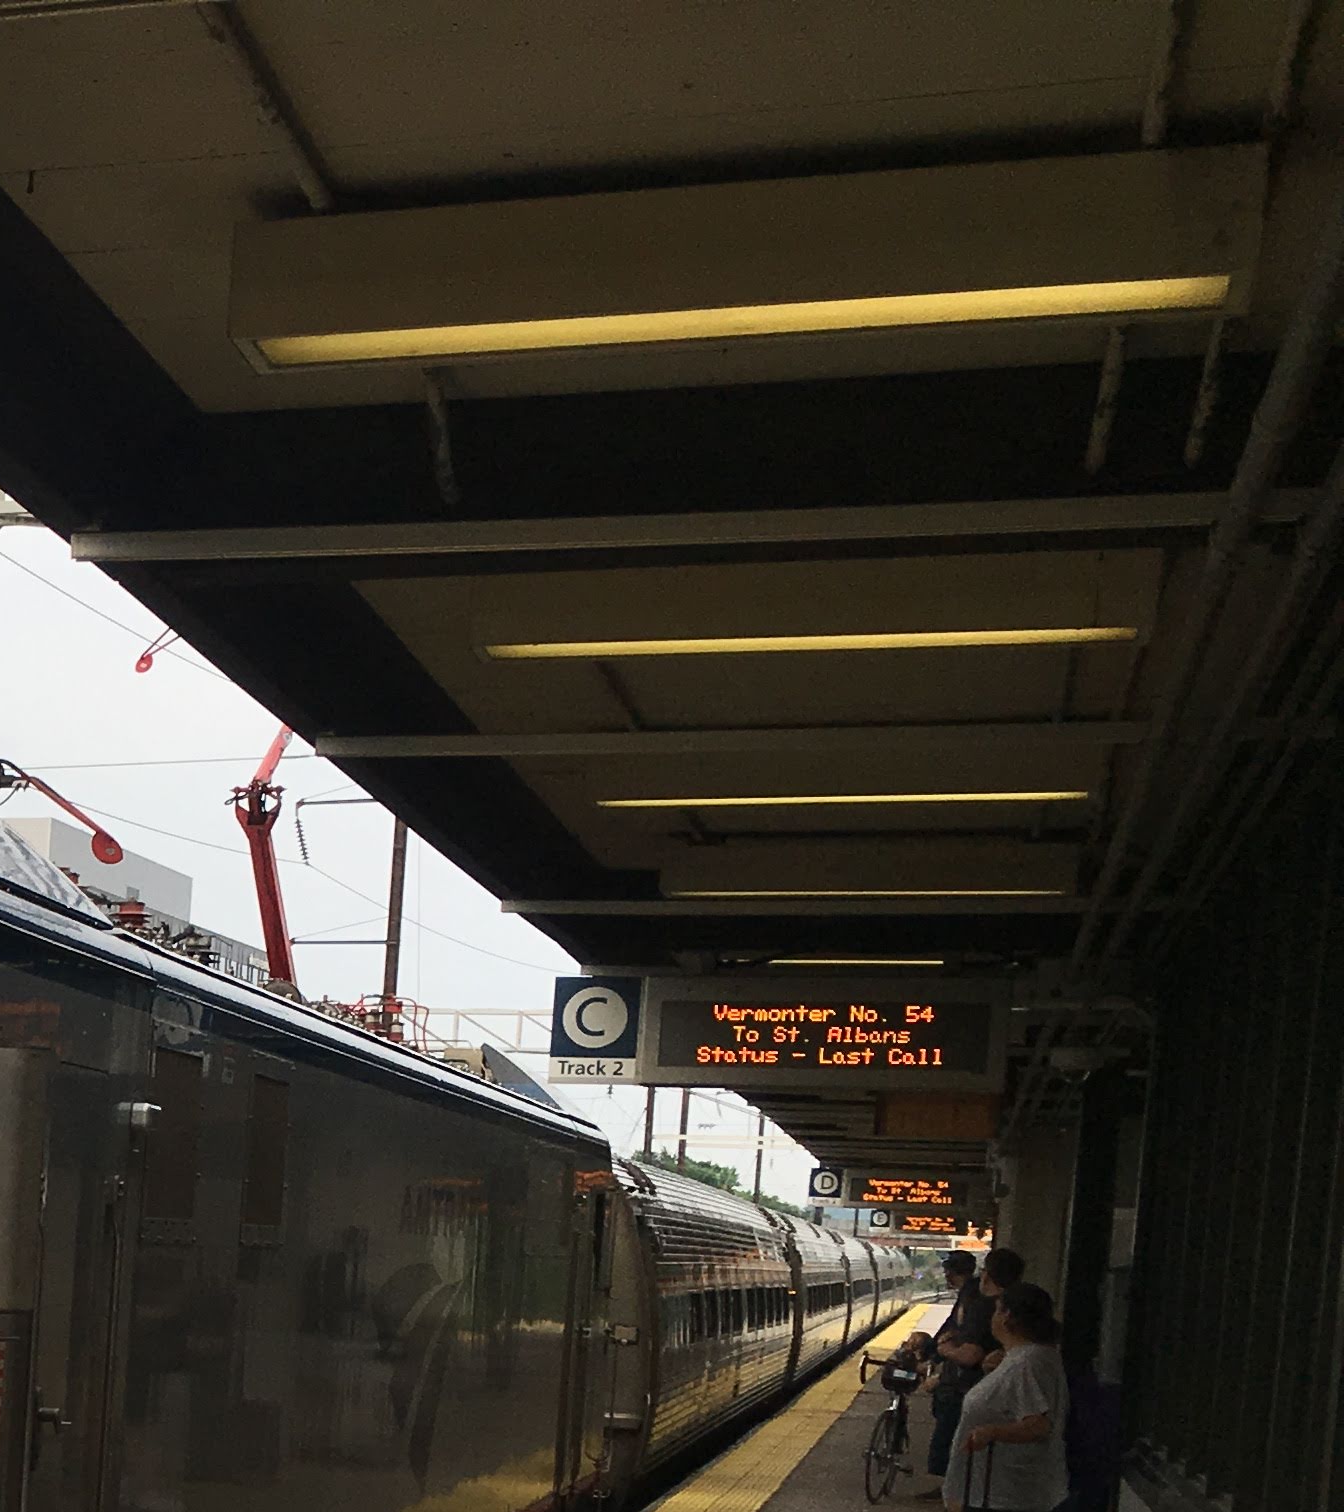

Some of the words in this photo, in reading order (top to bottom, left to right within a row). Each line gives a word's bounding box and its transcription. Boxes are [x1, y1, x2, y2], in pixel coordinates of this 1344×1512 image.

[575, 996, 609, 1037] C
[713, 1004, 837, 1023] Vermonter
[849, 1005, 888, 1023] No.
[905, 1005, 935, 1023] 54
[732, 1025, 760, 1043] To
[772, 1026, 810, 1044] St.
[826, 1026, 911, 1044] Albans
[696, 1046, 779, 1064] Status
[818, 1047, 875, 1065] Last
[887, 1048, 943, 1066] Call
[557, 1060, 606, 1076] Track
[612, 1061, 624, 1076] 2
[820, 1175, 835, 1190] D
